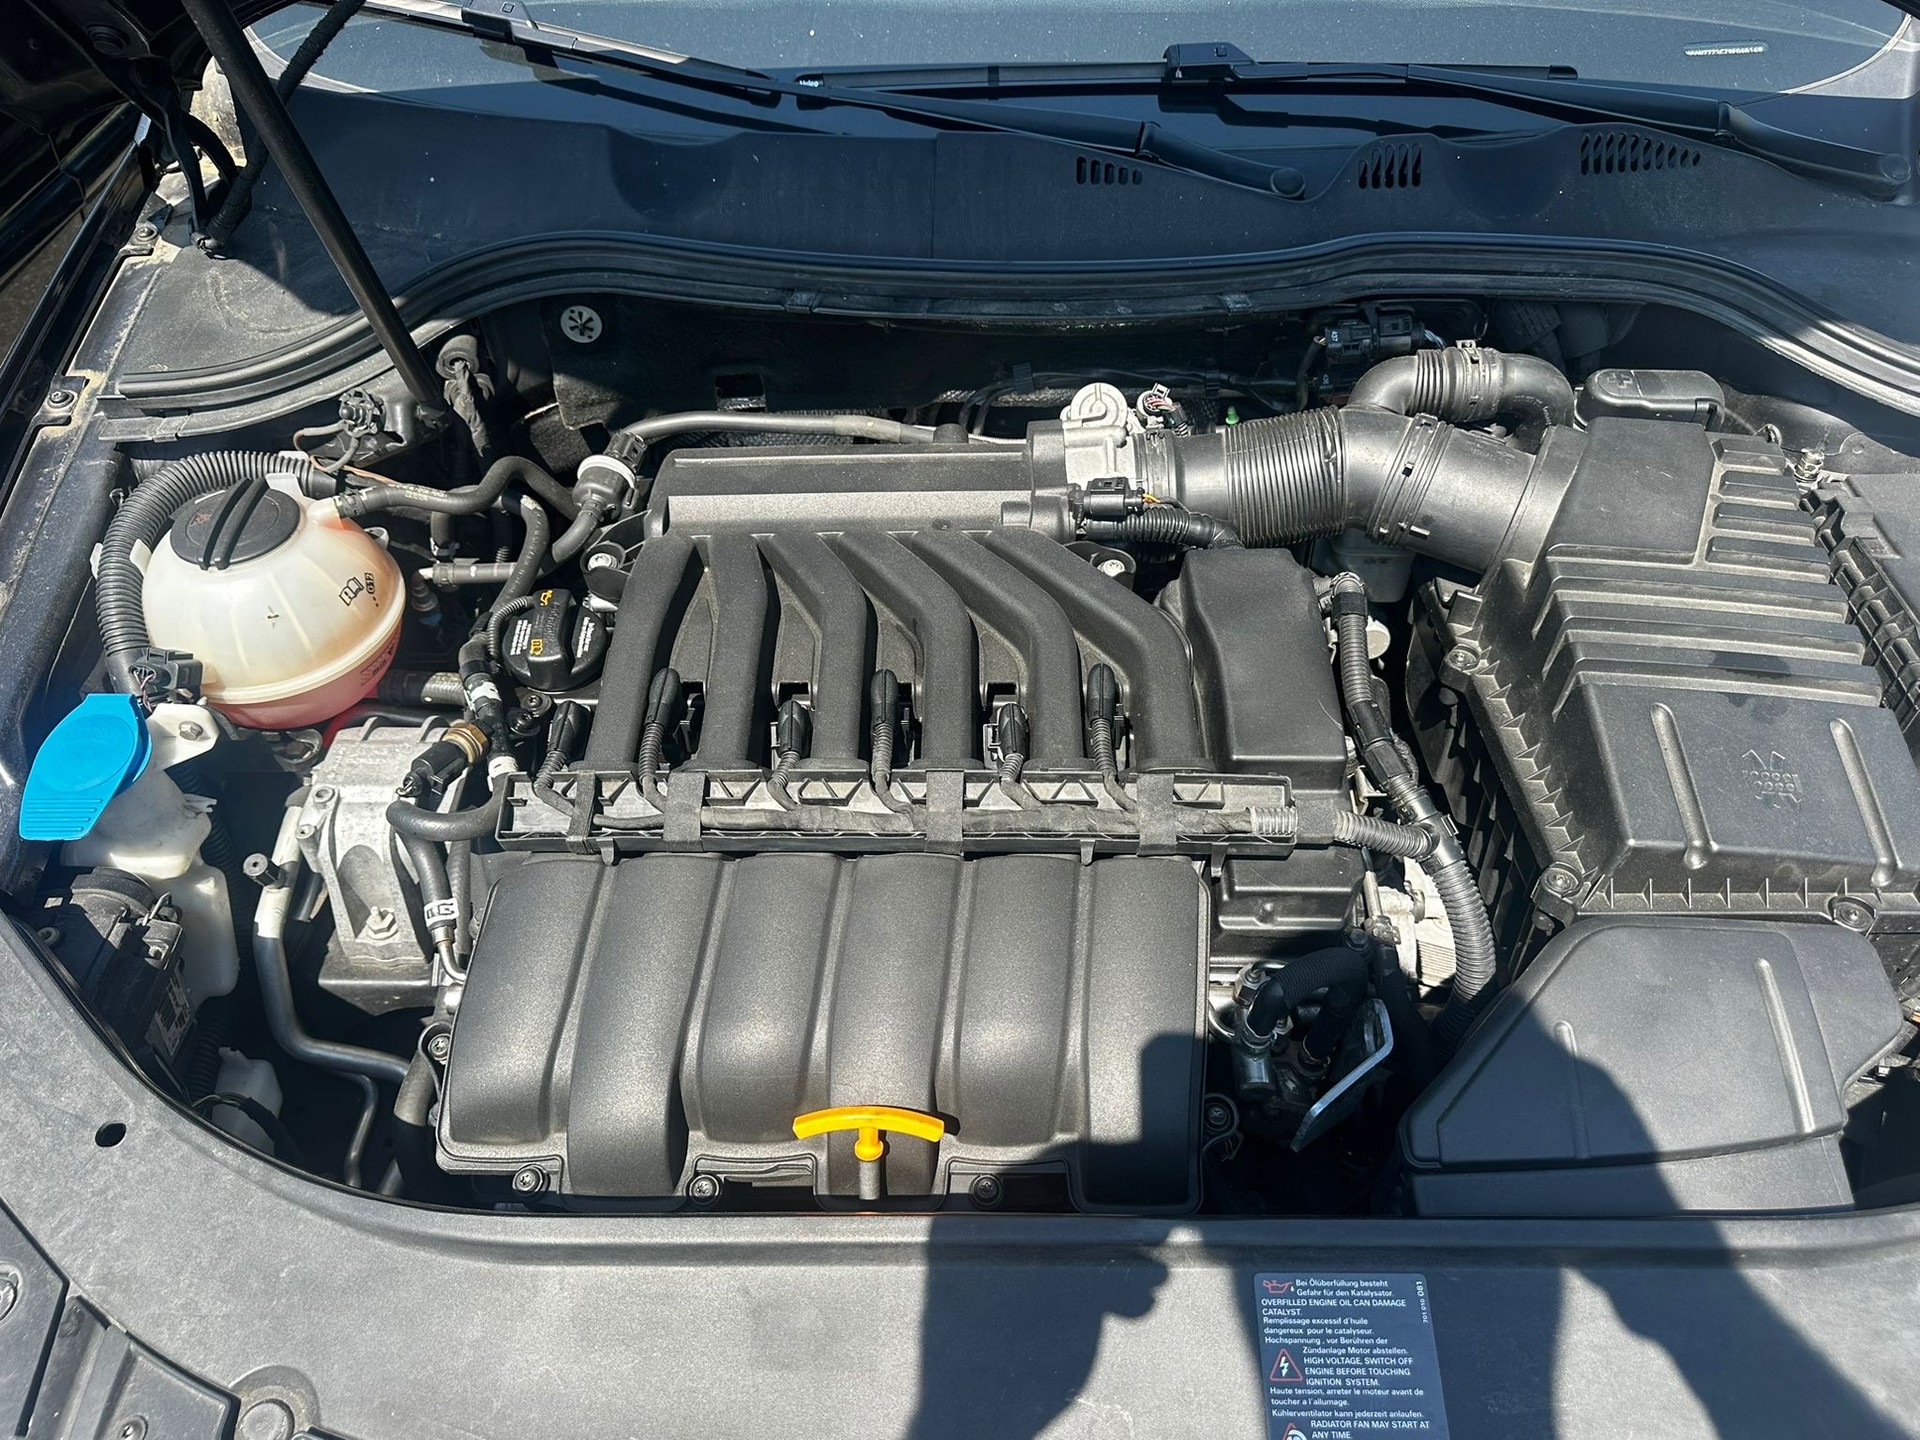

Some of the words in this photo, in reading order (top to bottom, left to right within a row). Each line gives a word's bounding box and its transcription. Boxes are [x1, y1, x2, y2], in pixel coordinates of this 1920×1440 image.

[1295, 1279, 1308, 1287] Bei
[1309, 1278, 1359, 1288] Ölüberfüllung
[1296, 1288, 1322, 1296] Gefahr
[1350, 1289, 1395, 1298] Katalysator.
[1415, 1281, 1425, 1297] 081
[1261, 1298, 1308, 1306] OVERFILLED
[1309, 1298, 1338, 1306] ENGINE
[1353, 1299, 1371, 1307] CAN
[1372, 1299, 1407, 1307] DAMAGE
[1419, 1298, 1427, 1311] 010
[1262, 1308, 1303, 1316] CATALYST.
[1263, 1316, 1310, 1326] Remplissage
[1311, 1317, 1342, 1325] excessif
[1263, 1326, 1304, 1336] dangereux
[1306, 1327, 1325, 1336] pour
[1334, 1327, 1374, 1336] catalyseur.
[1340, 1336, 1375, 1345] Berühren
[1375, 1337, 1388, 1345] der
[1302, 1346, 1347, 1356] Zündanlage
[1347, 1346, 1371, 1354] Motor
[1303, 1356, 1324, 1364] HIGH
[1364, 1357, 1397, 1365] SWITCH
[1398, 1357, 1413, 1365] OFF
[1304, 1367, 1335, 1375] ENGINE
[1336, 1367, 1367, 1375] BEFORE
[1368, 1367, 1411, 1376] TOUCHING
[1306, 1378, 1342, 1386] IGNITION
[1345, 1378, 1381, 1386] SYSTEM.
[1269, 1387, 1294, 1395] Haute
[1413, 1388, 1424, 1396] de
[1271, 1398, 1301, 1406] toucher
[1271, 1408, 1333, 1417] Kühlerventilator
[1334, 1409, 1354, 1417] kann
[1354, 1409, 1388, 1418] jederzeit
[1389, 1409, 1425, 1418] anlaufen.
[1310, 1420, 1352, 1428] RADIATOR
[1353, 1420, 1371, 1428] FAN
[1371, 1420, 1390, 1428] MAY
[1391, 1420, 1418, 1429] START
[1419, 1420, 1431, 1429] AT
[1311, 1431, 1331, 1439] ANY
[1331, 1431, 1354, 1439] TIME.
